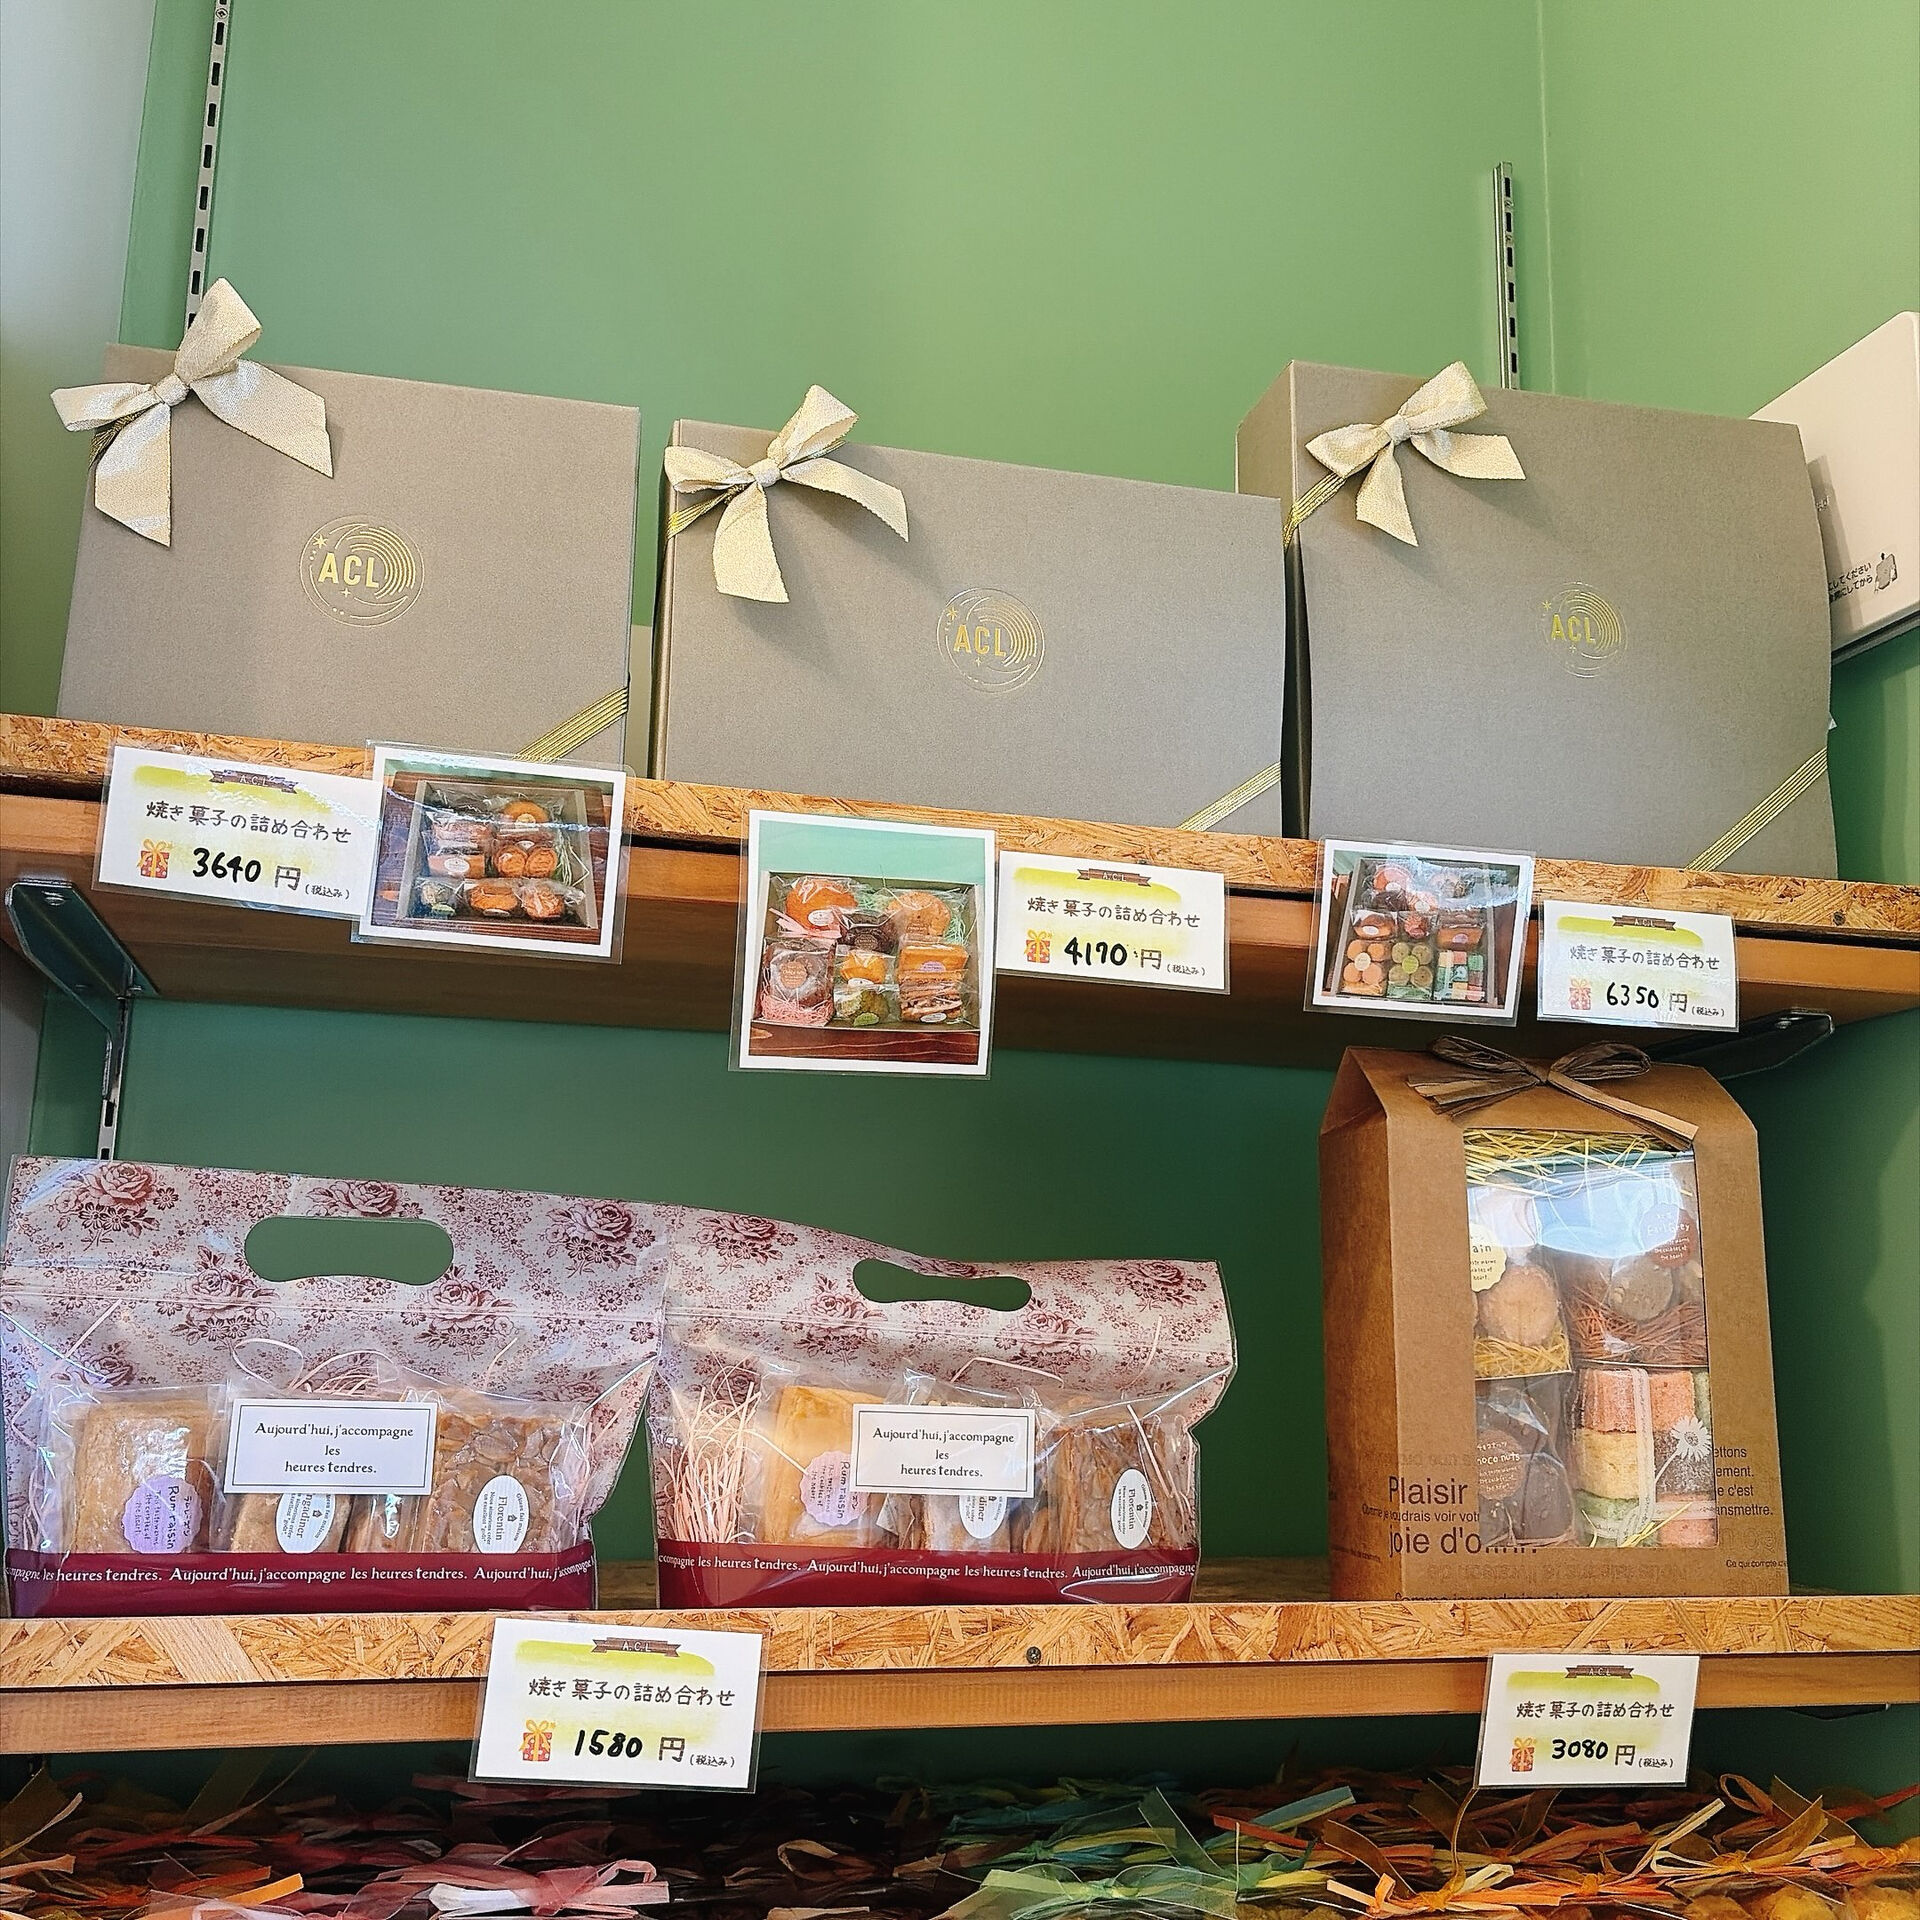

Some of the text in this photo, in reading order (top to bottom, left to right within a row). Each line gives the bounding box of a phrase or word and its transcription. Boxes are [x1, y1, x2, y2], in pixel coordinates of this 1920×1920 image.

[318, 552, 380, 588] ACL
[953, 624, 1006, 657] ACL
[1551, 613, 1597, 645] ACL
[146, 800, 352, 844] 焼き菓子の詰め合わせ
[192, 848, 261, 884] 3640
[274, 865, 301, 891] 円
[1027, 897, 1201, 929] 焼き菓子の詰め合わせ
[1064, 936, 1128, 966] 4170
[1140, 949, 1162, 970] 円
[1570, 944, 1720, 971] 焼き菓子の詰め合わせ
[1606, 982, 1660, 1008] 6350
[1670, 992, 1688, 1013] 円
[334, 1423, 414, 1440] j'accompagne
[942, 1429, 1015, 1446] j'accompagne
[324, 1444, 341, 1456] les
[935, 1449, 949, 1460] les
[284, 1461, 377, 1474] heures tendres.
[900, 1463, 983, 1478] heures tendres.
[837, 1461, 851, 1519] Rum raisin
[1388, 1476, 1468, 1505] Plaisir
[1727, 1485, 1754, 1497] c'est
[166, 1485, 180, 1550] Rum raisin
[296, 1493, 315, 1539] ngadiner
[495, 1496, 508, 1541] Florentin
[1128, 1488, 1136, 1530] Florentin
[1434, 1510, 1457, 1522] voir
[1389, 1525, 1430, 1558] joie
[56, 1569, 103, 1582] heures
[105, 1568, 163, 1582] tendres.
[257, 1568, 346, 1584] j'accompagne
[350, 1567, 368, 1580] les
[371, 1567, 413, 1580] heures
[415, 1567, 468, 1580] tendres.
[698, 1555, 712, 1568] les
[714, 1556, 752, 1569] heures
[754, 1557, 801, 1571] tendres.
[882, 1562, 961, 1579] j'accompagne
[964, 1565, 980, 1577] les
[982, 1565, 1022, 1578] heures
[1023, 1566, 1068, 1579] tendres.
[528, 1676, 736, 1707] 焼き菓子の詰め合わせ
[1516, 1700, 1675, 1720] 焼き菓子の詰め合わせ
[574, 1729, 643, 1758] 1580
[658, 1736, 686, 1763] 円
[1551, 1739, 1609, 1760] 3080
[1615, 1745, 1636, 1766] 円
